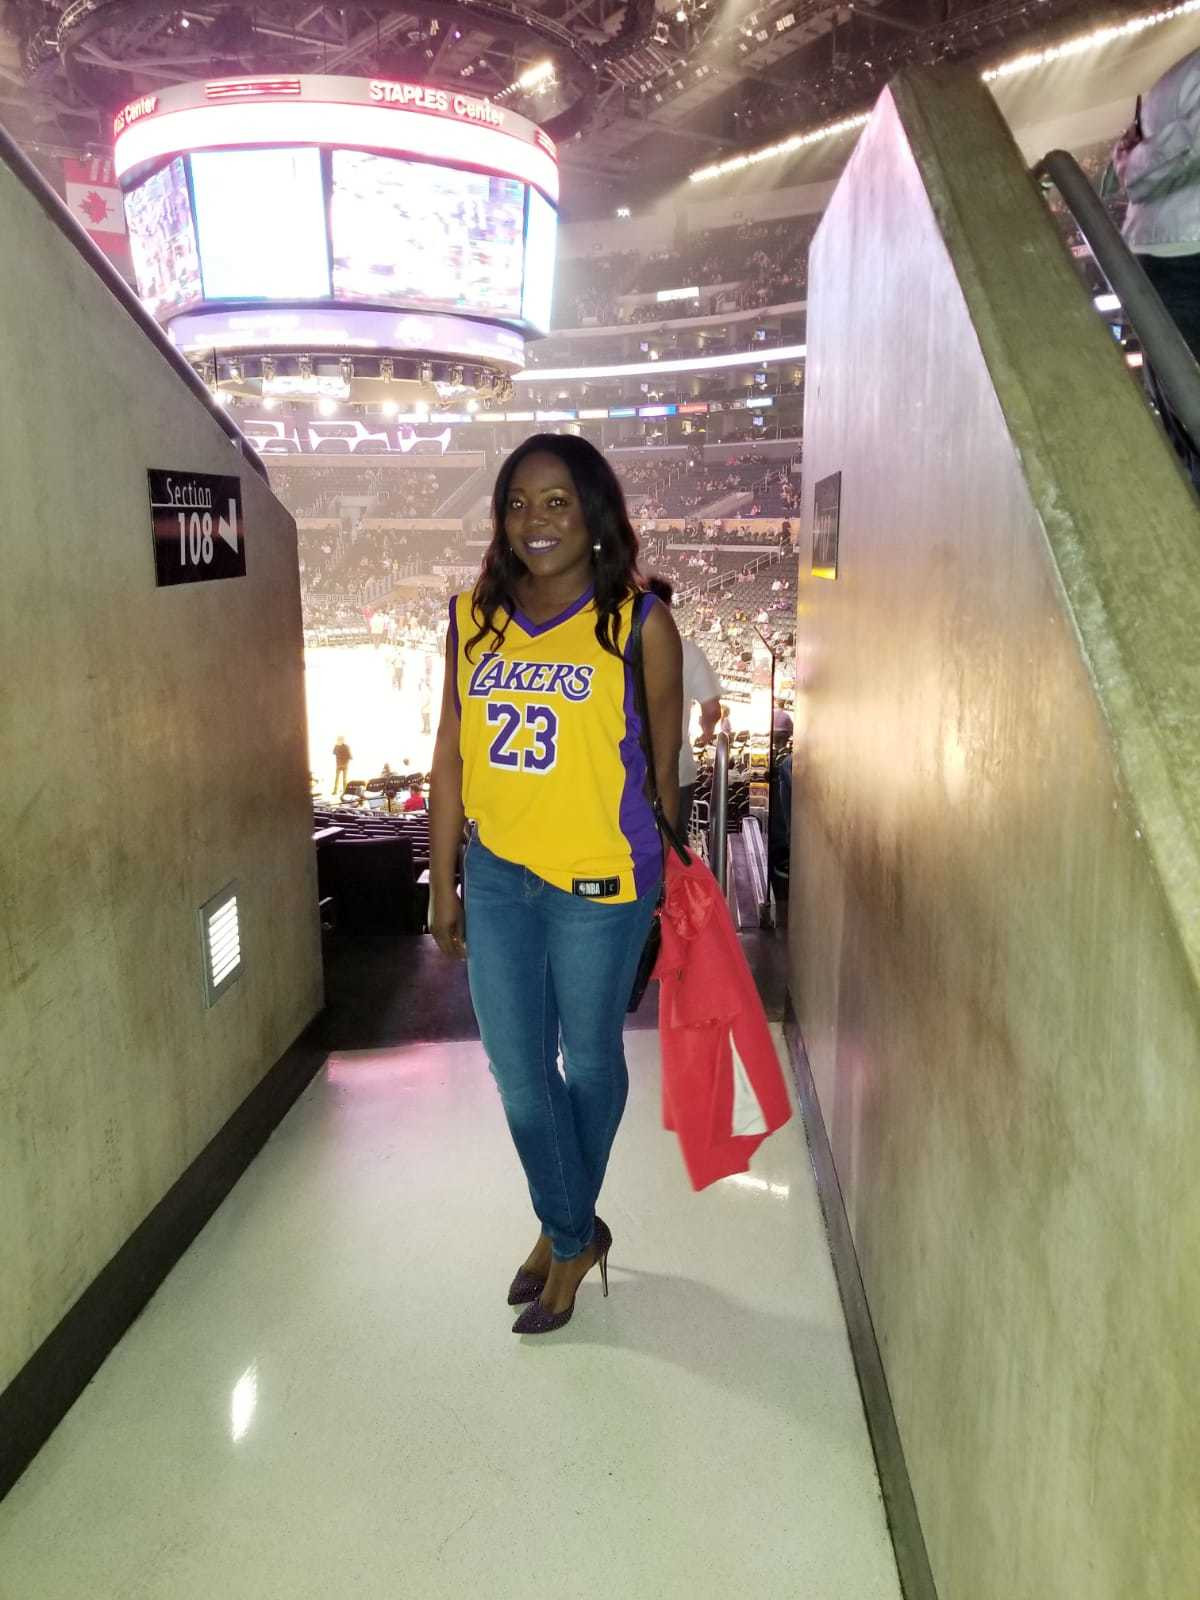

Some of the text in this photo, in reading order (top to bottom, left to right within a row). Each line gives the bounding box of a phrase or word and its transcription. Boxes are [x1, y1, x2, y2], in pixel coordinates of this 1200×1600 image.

[368, 80, 504, 125] STAPLES Center
[166, 477, 212, 506] Section
[178, 511, 214, 566] 108
[468, 652, 595, 702] LAKERS
[486, 701, 559, 775] 23
[585, 882, 601, 895] NBA
